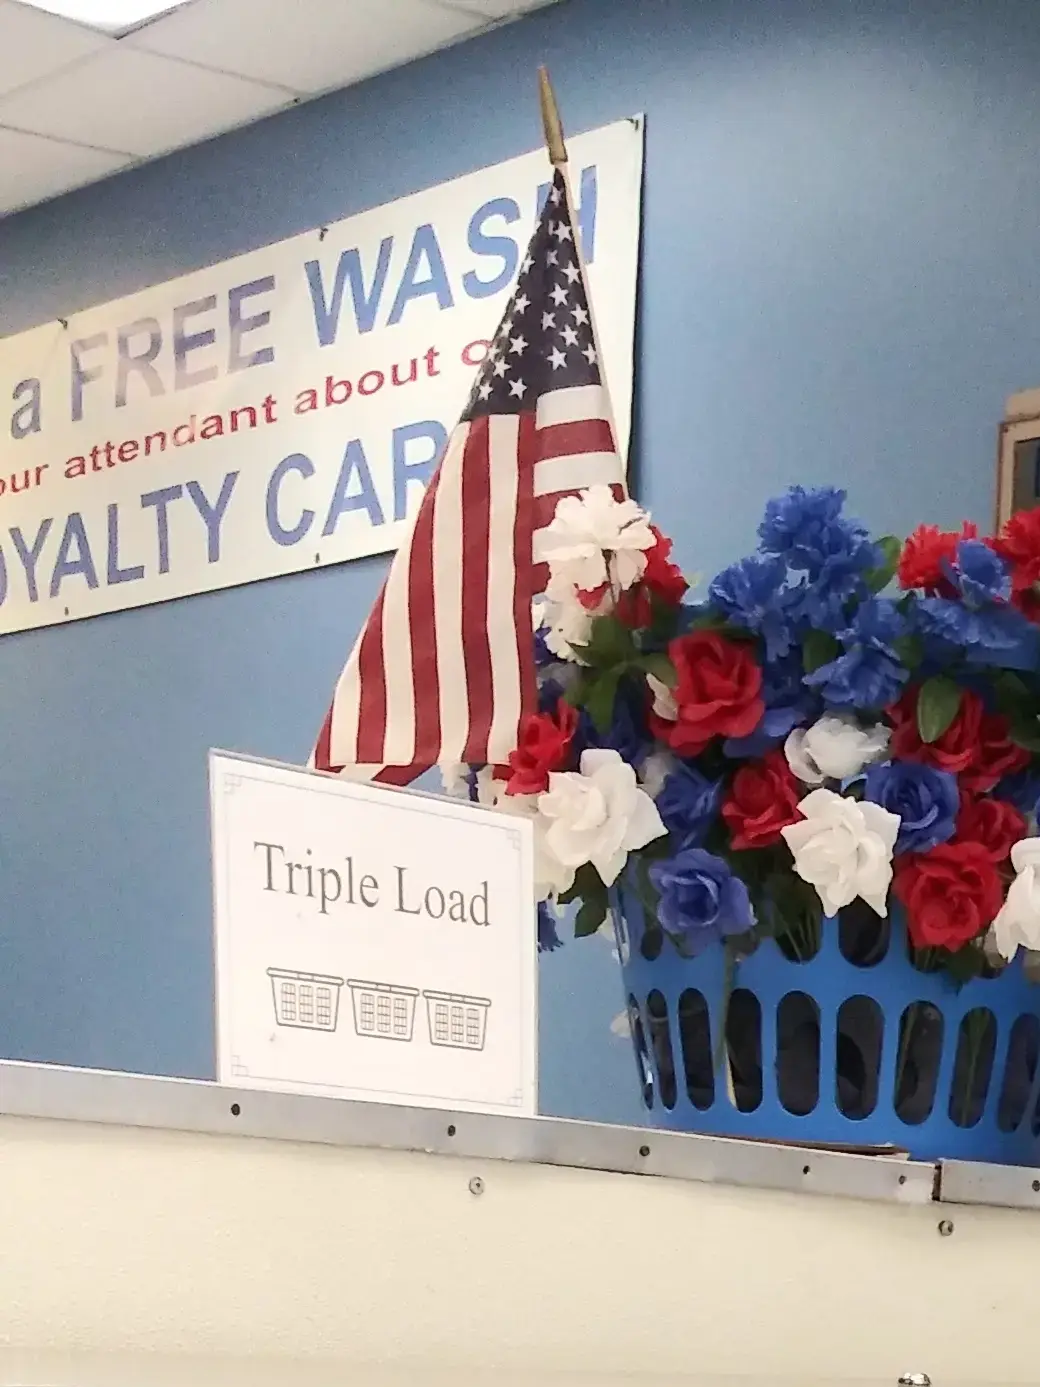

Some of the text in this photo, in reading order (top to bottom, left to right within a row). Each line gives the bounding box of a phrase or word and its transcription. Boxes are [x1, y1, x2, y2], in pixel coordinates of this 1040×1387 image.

[0, 345, 440, 496] ur attendant about
[10, 376, 41, 440] a
[69, 274, 275, 422] FREE
[0, 419, 449, 606] YALTY CAR
[254, 841, 491, 928] Triple Load
